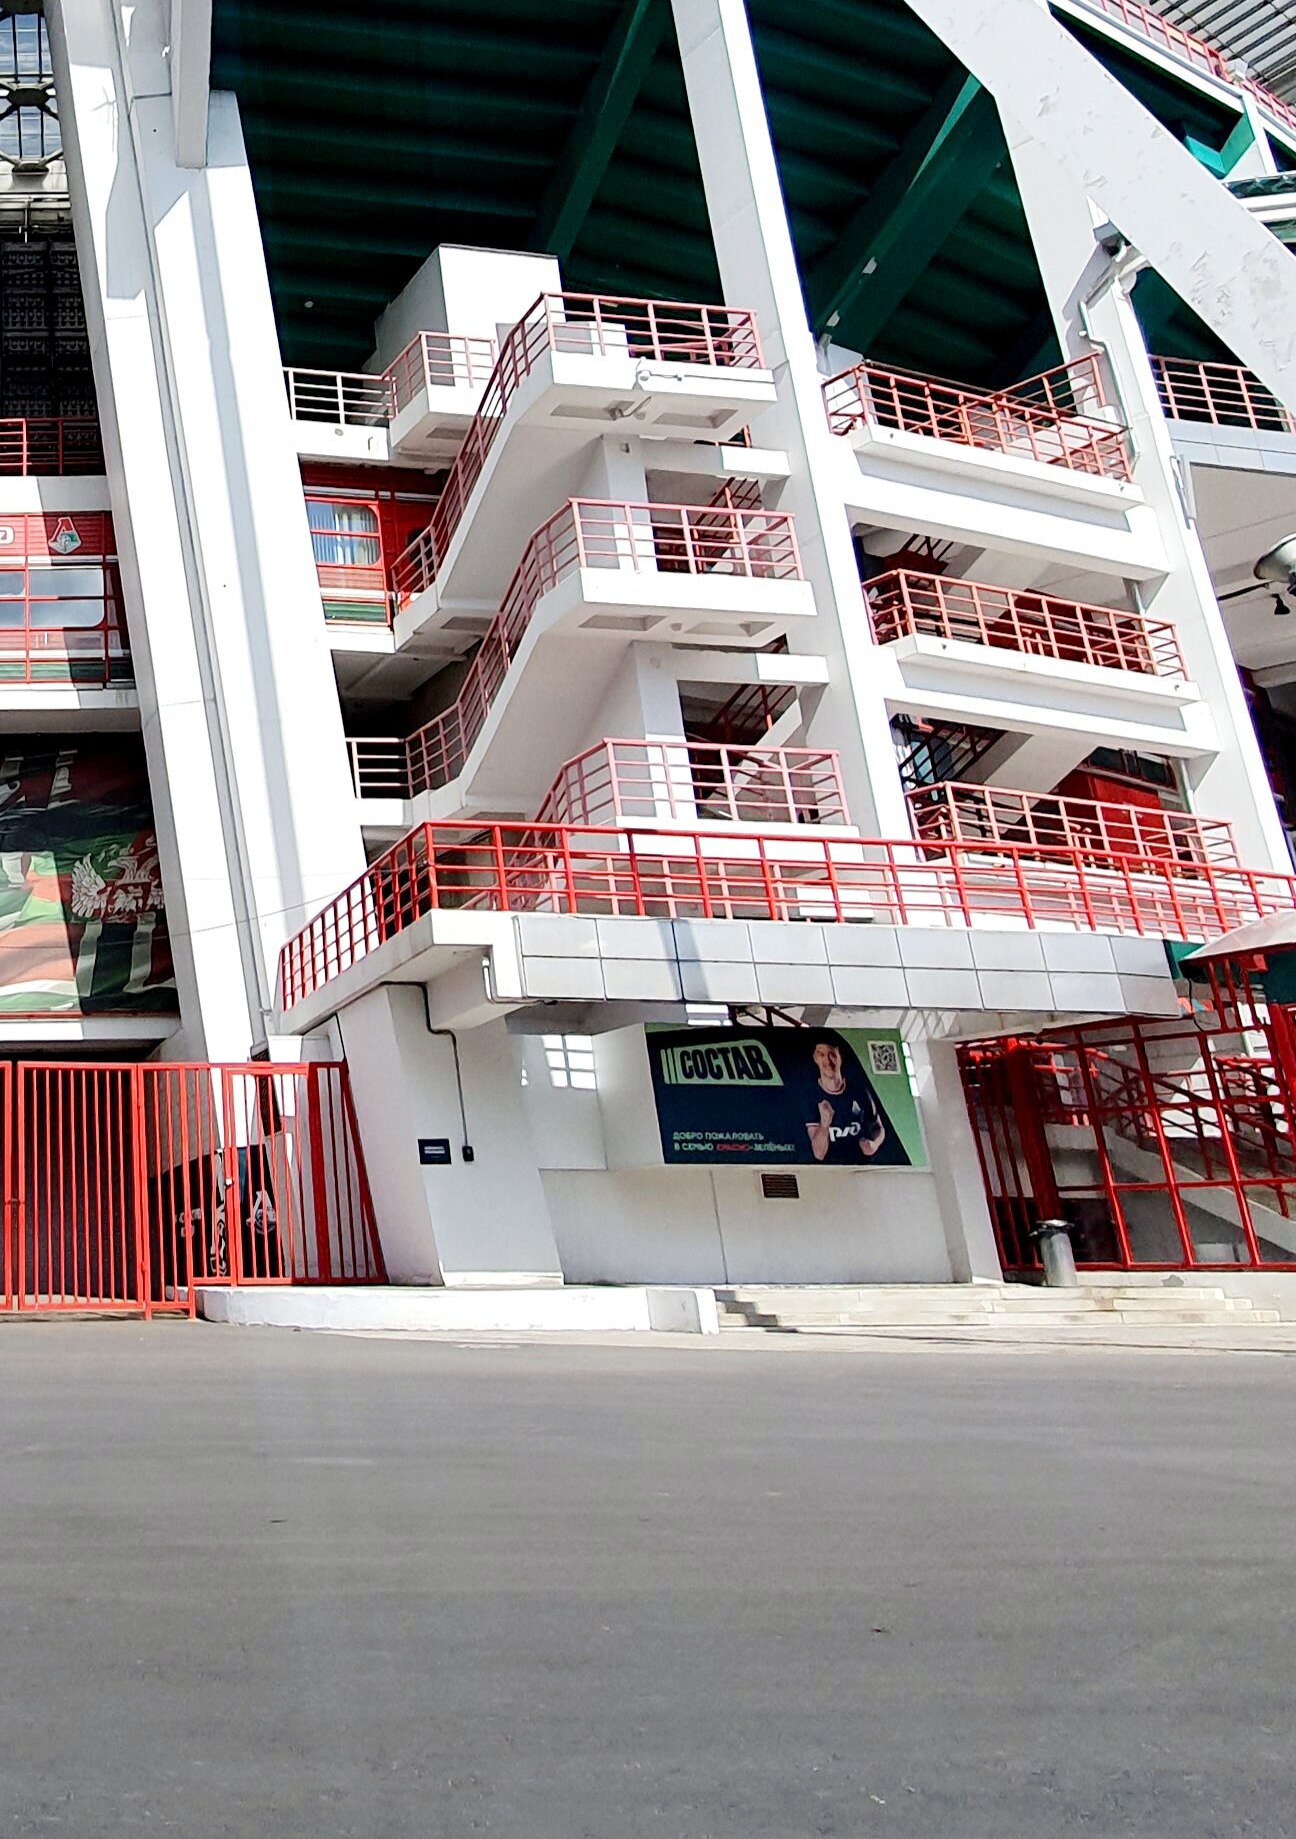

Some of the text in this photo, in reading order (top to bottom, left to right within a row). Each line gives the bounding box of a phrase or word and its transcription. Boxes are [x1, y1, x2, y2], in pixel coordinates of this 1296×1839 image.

[679, 1045, 773, 1080] СОСТАВ
[673, 1132, 764, 1141] ДОБРО ПОЖАЛОВАТЬ
[674, 1143, 681, 1151] В
